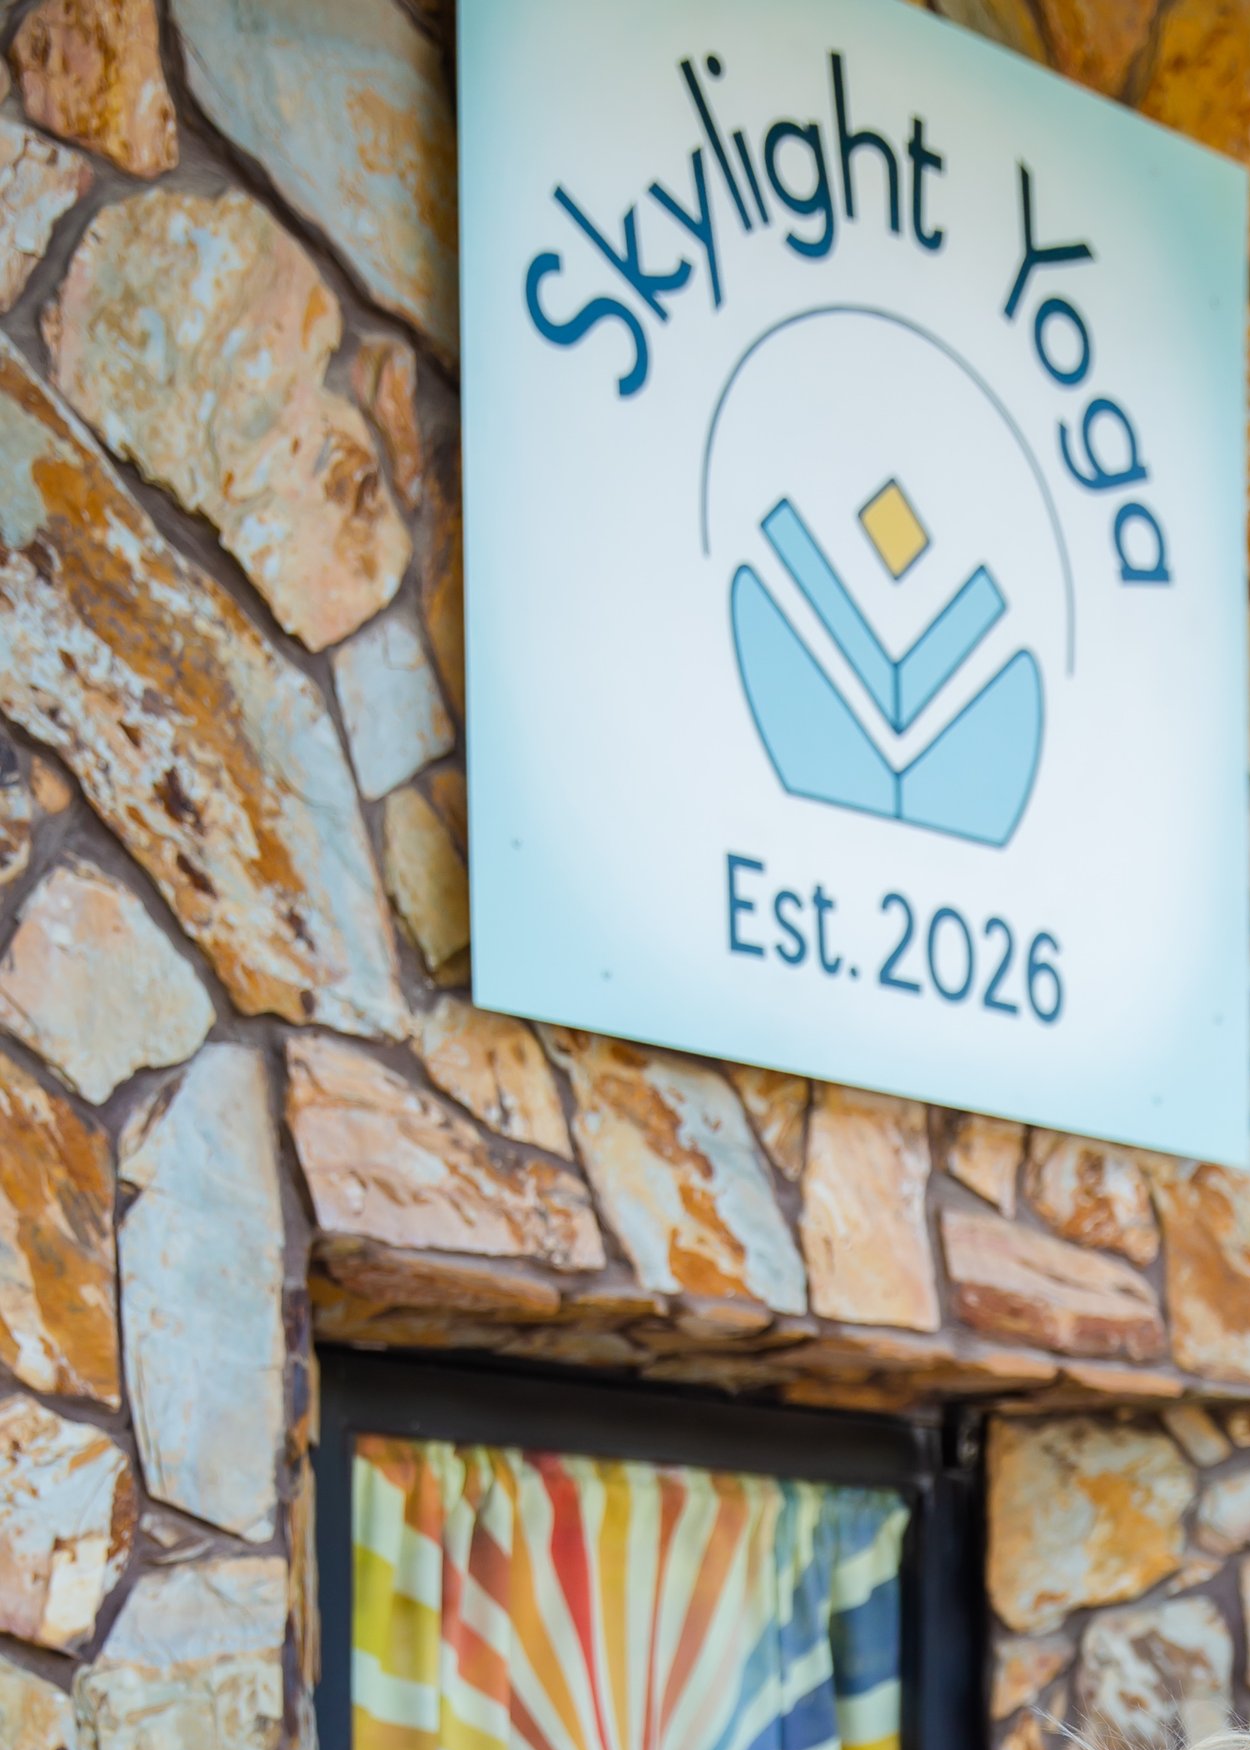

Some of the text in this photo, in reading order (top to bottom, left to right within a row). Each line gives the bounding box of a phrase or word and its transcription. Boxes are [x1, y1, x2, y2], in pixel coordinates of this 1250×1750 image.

[523, 48, 1172, 587] Skylight Yoga
[725, 852, 1065, 1025] Est. 2026
